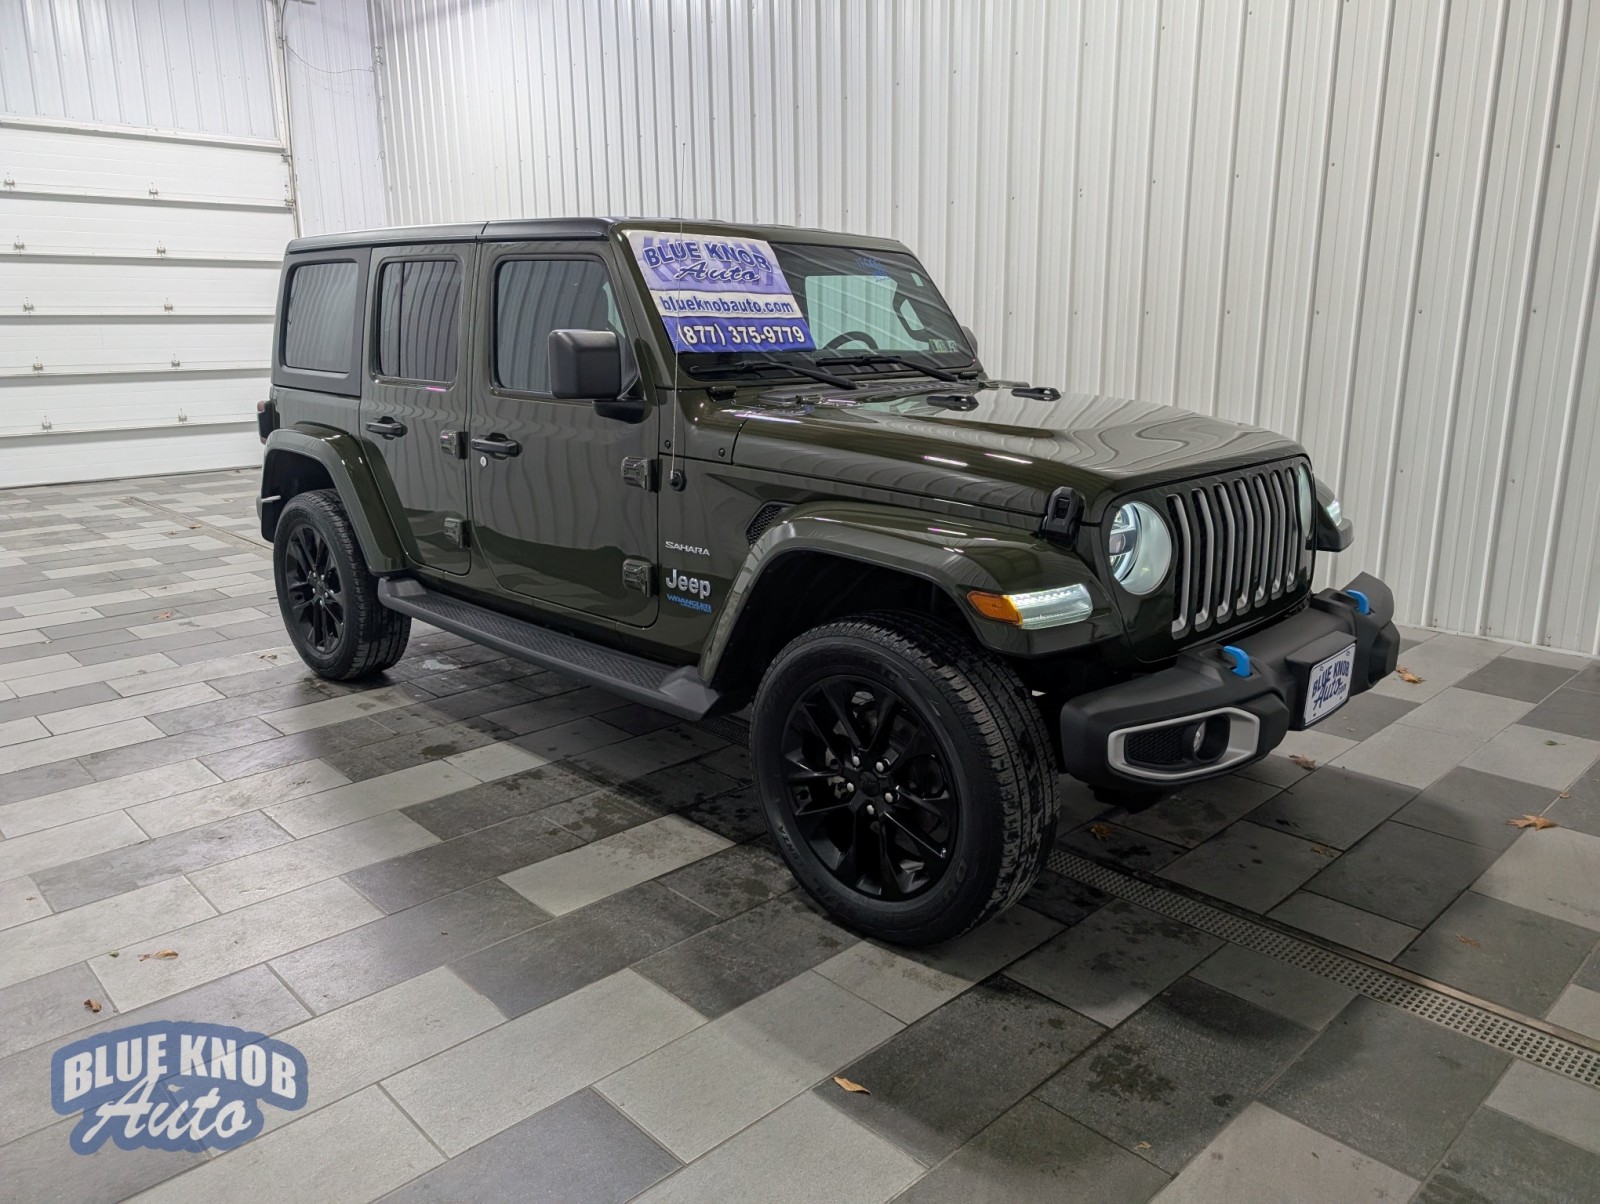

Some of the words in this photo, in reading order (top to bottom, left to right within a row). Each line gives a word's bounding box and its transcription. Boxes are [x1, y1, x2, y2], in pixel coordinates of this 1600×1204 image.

[644, 241, 702, 268] BLUE
[705, 242, 771, 272] KNOB
[674, 260, 760, 281] Auto
[659, 295, 794, 313] blueknobauto.com
[679, 323, 726, 345] (877)
[728, 325, 805, 344] 375-9779
[665, 541, 711, 556] SAHARA
[665, 568, 711, 600] Jeep
[667, 594, 711, 609] WRANGLER
[1312, 665, 1333, 699] BLUE
[1333, 660, 1350, 678] KNOB
[1312, 677, 1344, 711] Auto
